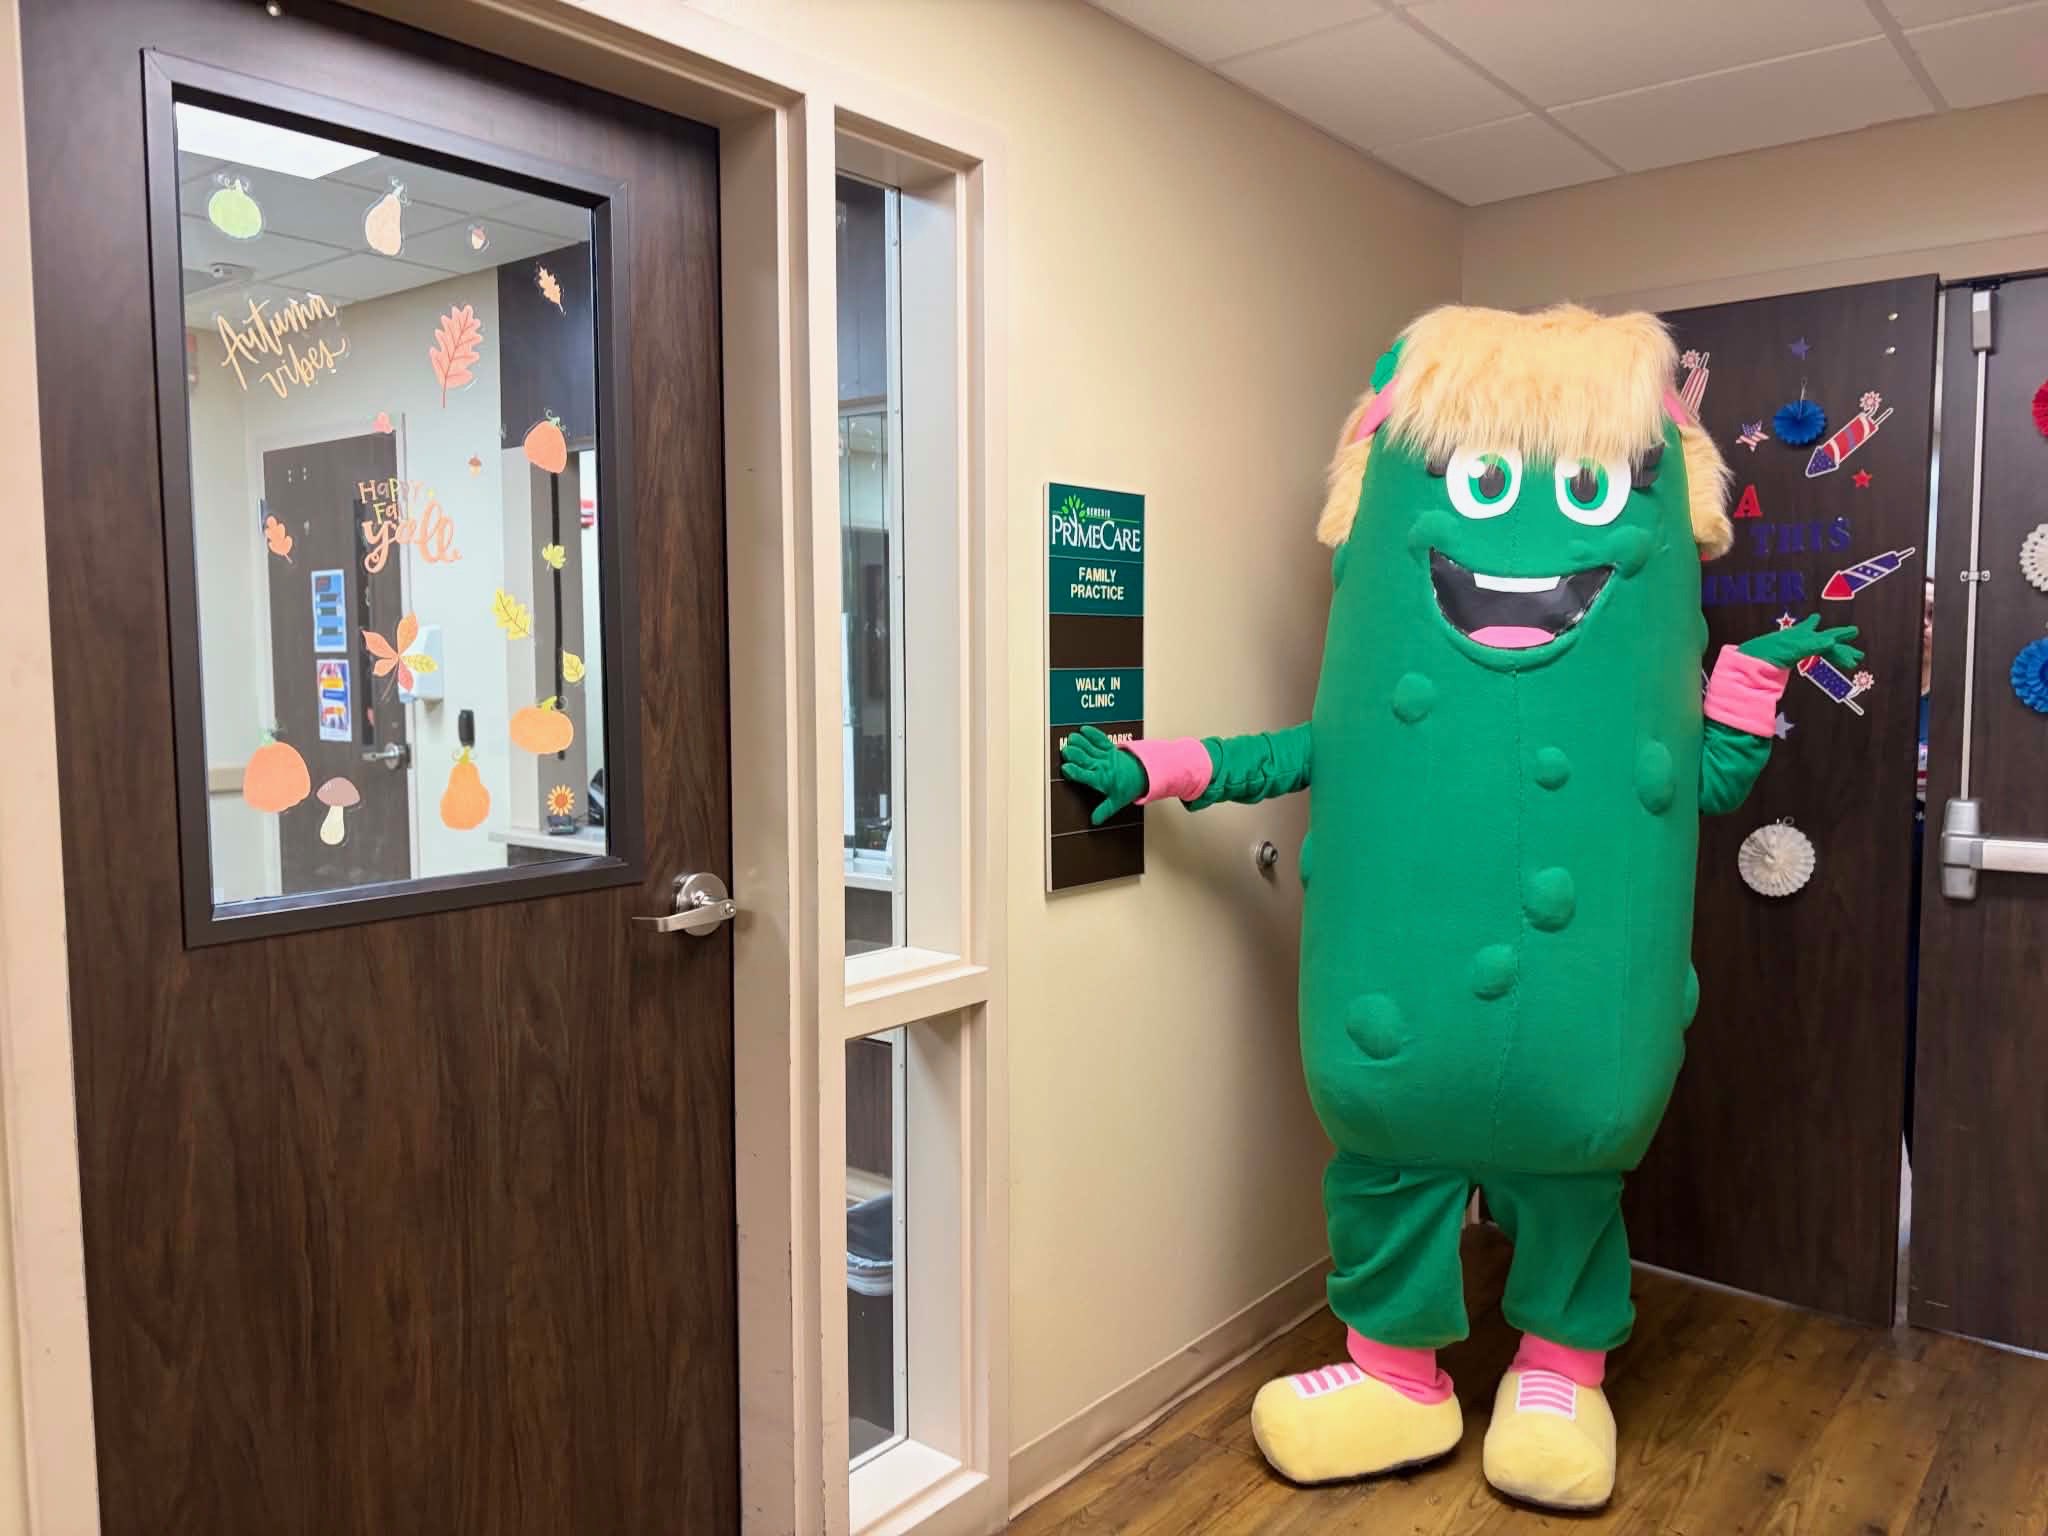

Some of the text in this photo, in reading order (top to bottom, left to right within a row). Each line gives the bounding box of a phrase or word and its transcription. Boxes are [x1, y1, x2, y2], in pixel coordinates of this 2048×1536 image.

[217, 292, 336, 391] Autumn
[259, 337, 346, 398] vibes
[1733, 483, 1763, 518] A
[1750, 516, 1851, 554] THIS
[1078, 566, 1117, 583] FAMILY
[1070, 583, 1124, 601] PRACTICE
[1075, 676, 1121, 692] WALK IN
[1081, 693, 1115, 709] CLINIC
